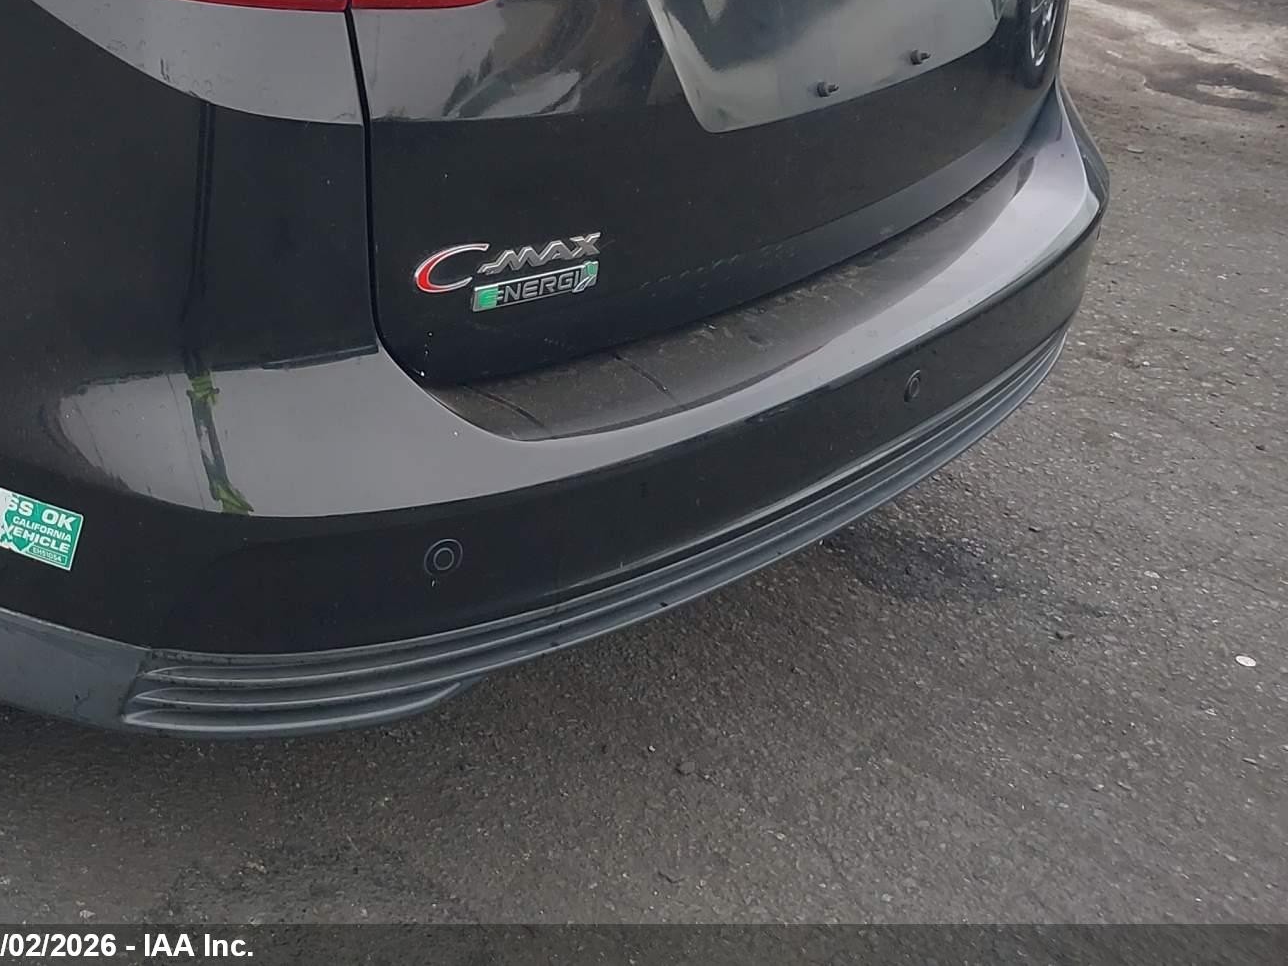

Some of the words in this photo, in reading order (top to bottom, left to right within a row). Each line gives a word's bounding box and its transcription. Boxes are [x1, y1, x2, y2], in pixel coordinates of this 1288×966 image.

[12, 515, 72, 542] CALIFORNIA
[41, 508, 77, 532] OK
[8, 525, 71, 554] VEHICLE
